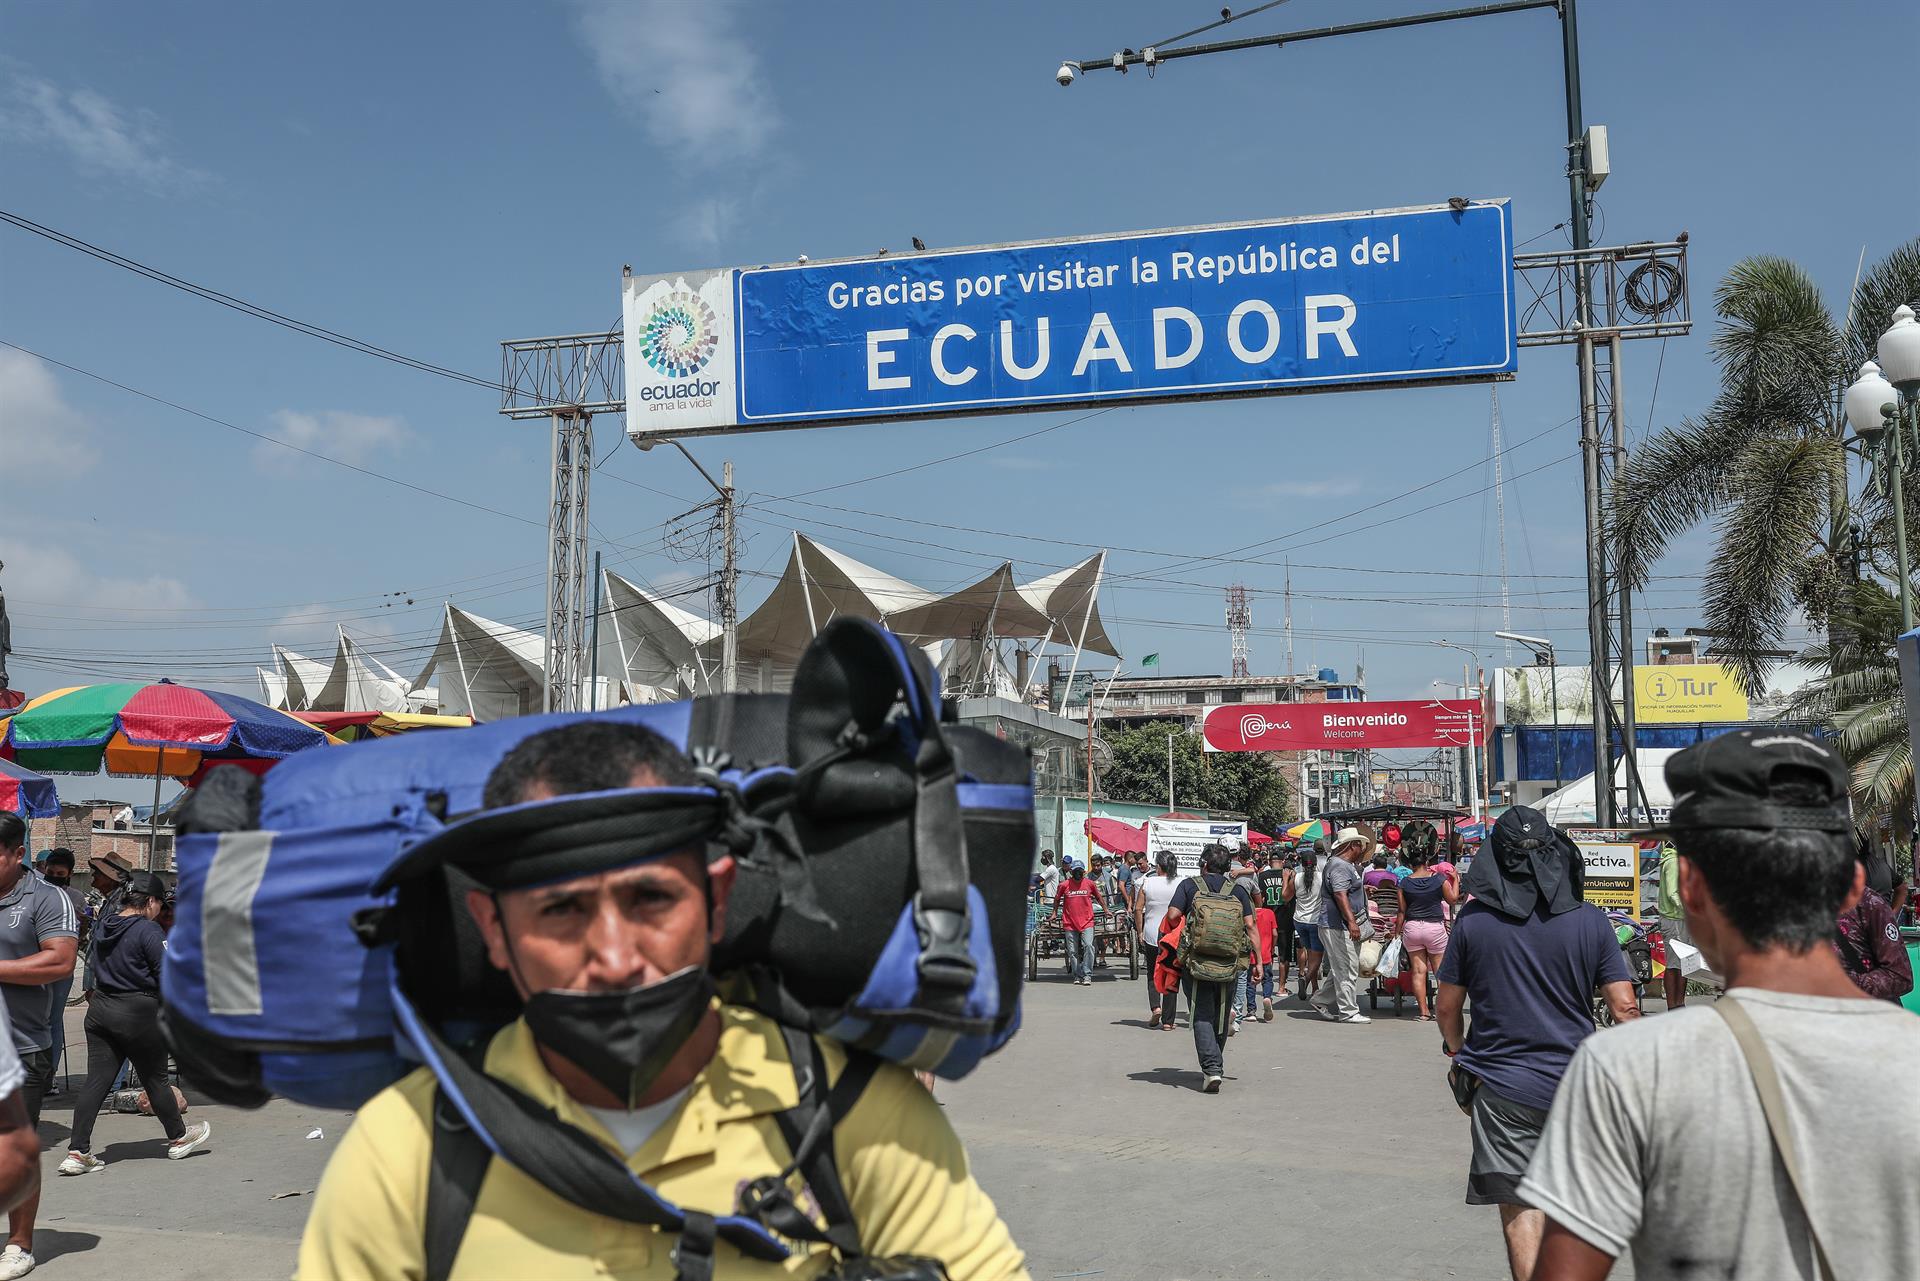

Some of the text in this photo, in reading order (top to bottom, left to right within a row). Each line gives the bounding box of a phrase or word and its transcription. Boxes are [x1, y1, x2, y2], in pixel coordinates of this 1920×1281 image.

[828, 233, 1400, 309] Gracias por visitar la República del
[866, 293, 1359, 391] ECUADOR
[640, 378, 720, 401] ecuador
[649, 398, 712, 412] ama la vida
[1677, 678, 1718, 696] Tur
[1323, 712, 1408, 728] Bienvenido
[1240, 713, 1292, 745] Perú
[1323, 729, 1365, 739] Welcome
[1263, 877, 1283, 887] IRVIN
[1584, 880, 1614, 888] ernUnion
